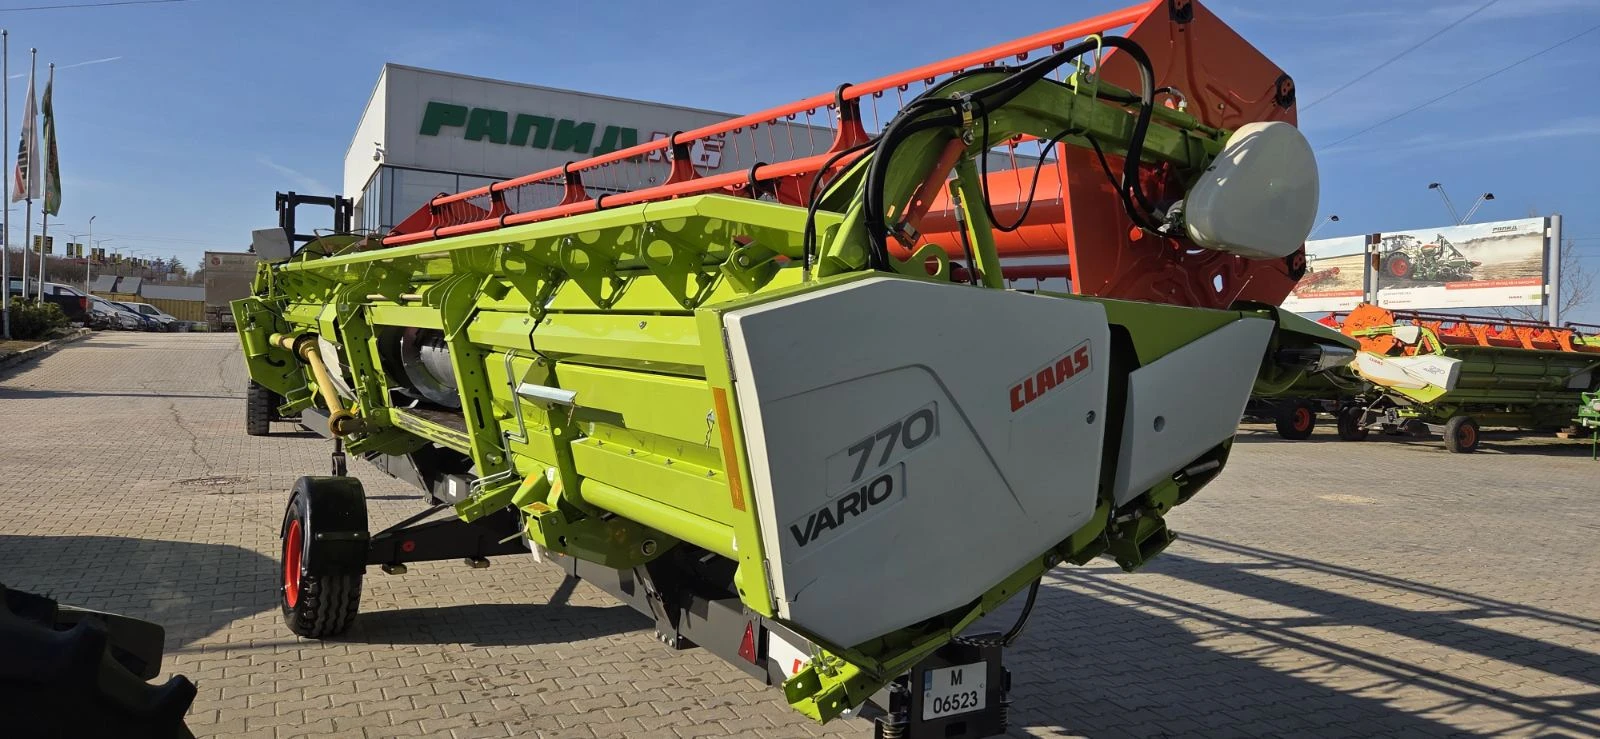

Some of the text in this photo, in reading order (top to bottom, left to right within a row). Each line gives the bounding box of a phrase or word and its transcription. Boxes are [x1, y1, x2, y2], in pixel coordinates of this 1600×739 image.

[419, 101, 642, 162] РАПИД
[1009, 345, 1089, 413] CLAAS
[848, 408, 934, 482] 770
[790, 474, 893, 547] VARIO
[933, 690, 978, 714] 06523
[950, 669, 963, 686] M
